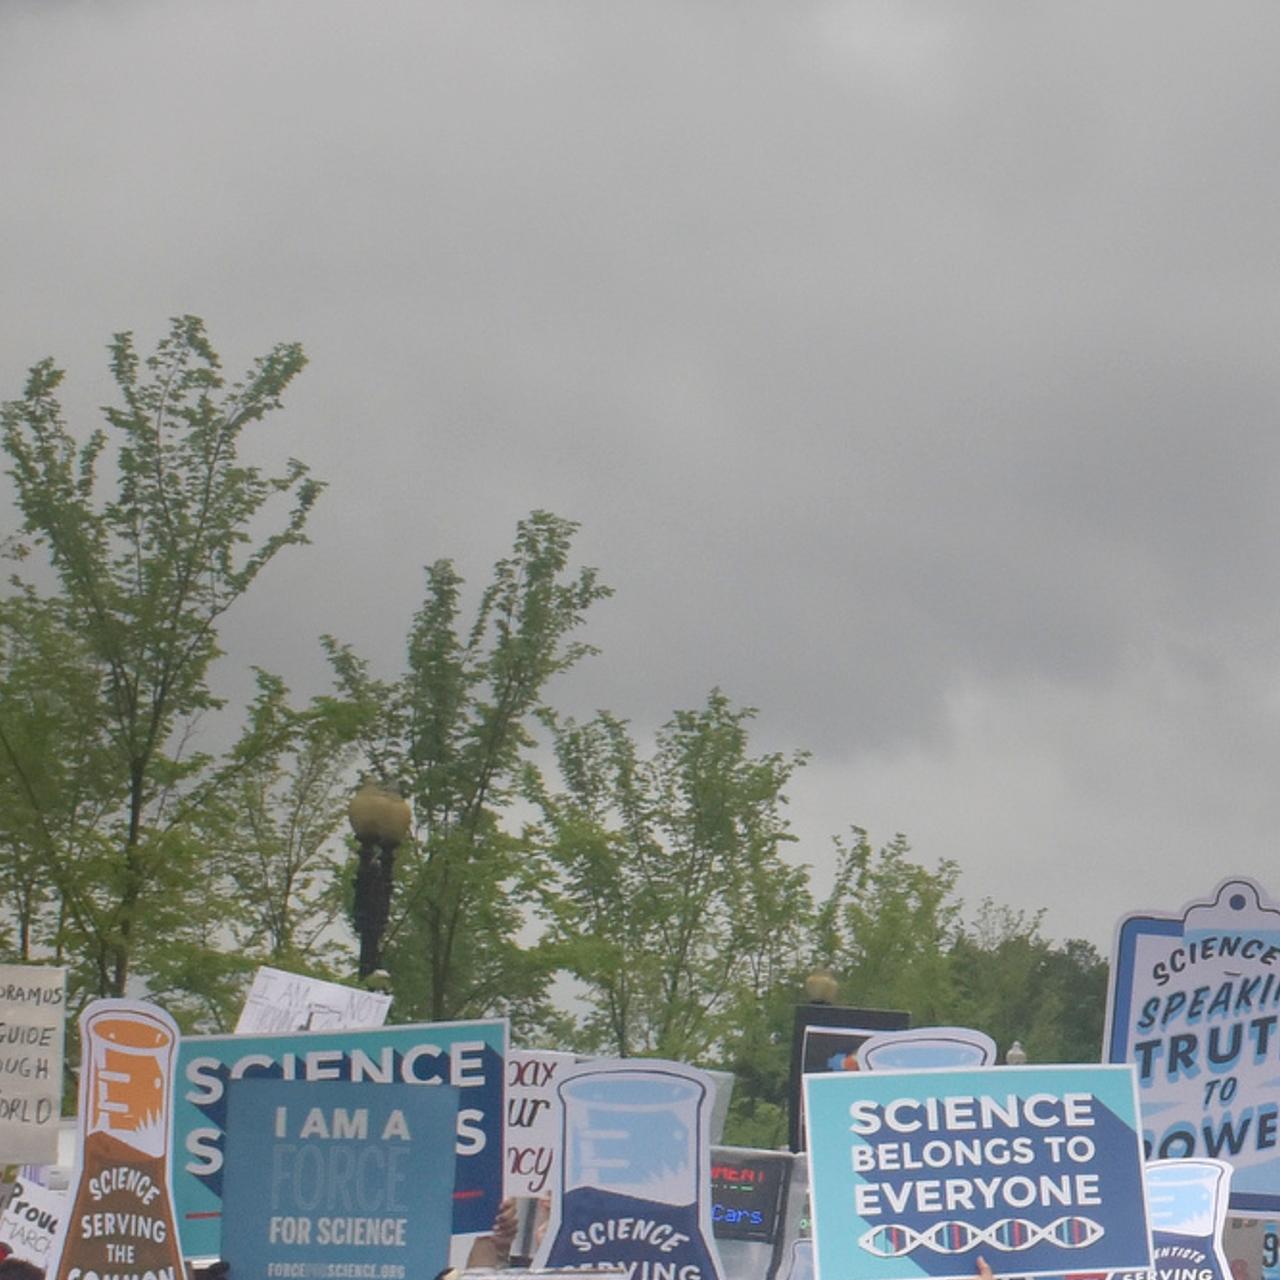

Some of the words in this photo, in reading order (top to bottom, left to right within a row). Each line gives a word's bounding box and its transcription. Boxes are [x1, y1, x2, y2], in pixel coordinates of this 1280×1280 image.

[1203, 1077, 1238, 1105] TO
[275, 1107, 287, 1138] I
[300, 1108, 369, 1140] AM
[382, 1110, 411, 1141] A
[849, 1093, 1096, 1135] SCIENCE
[852, 1138, 1035, 1173] BELONGS
[1043, 1136, 1096, 1163] TO
[89, 1167, 160, 1205] SCIENCE
[854, 1174, 1103, 1216] EVERYONE
[81, 1212, 166, 1244] SERVING
[711, 1204, 763, 1224] Cars
[269, 1216, 311, 1244] FOR
[317, 1217, 408, 1247] SCIENCE
[571, 1219, 691, 1253] SCIENCE
[106, 1244, 136, 1264] THE
